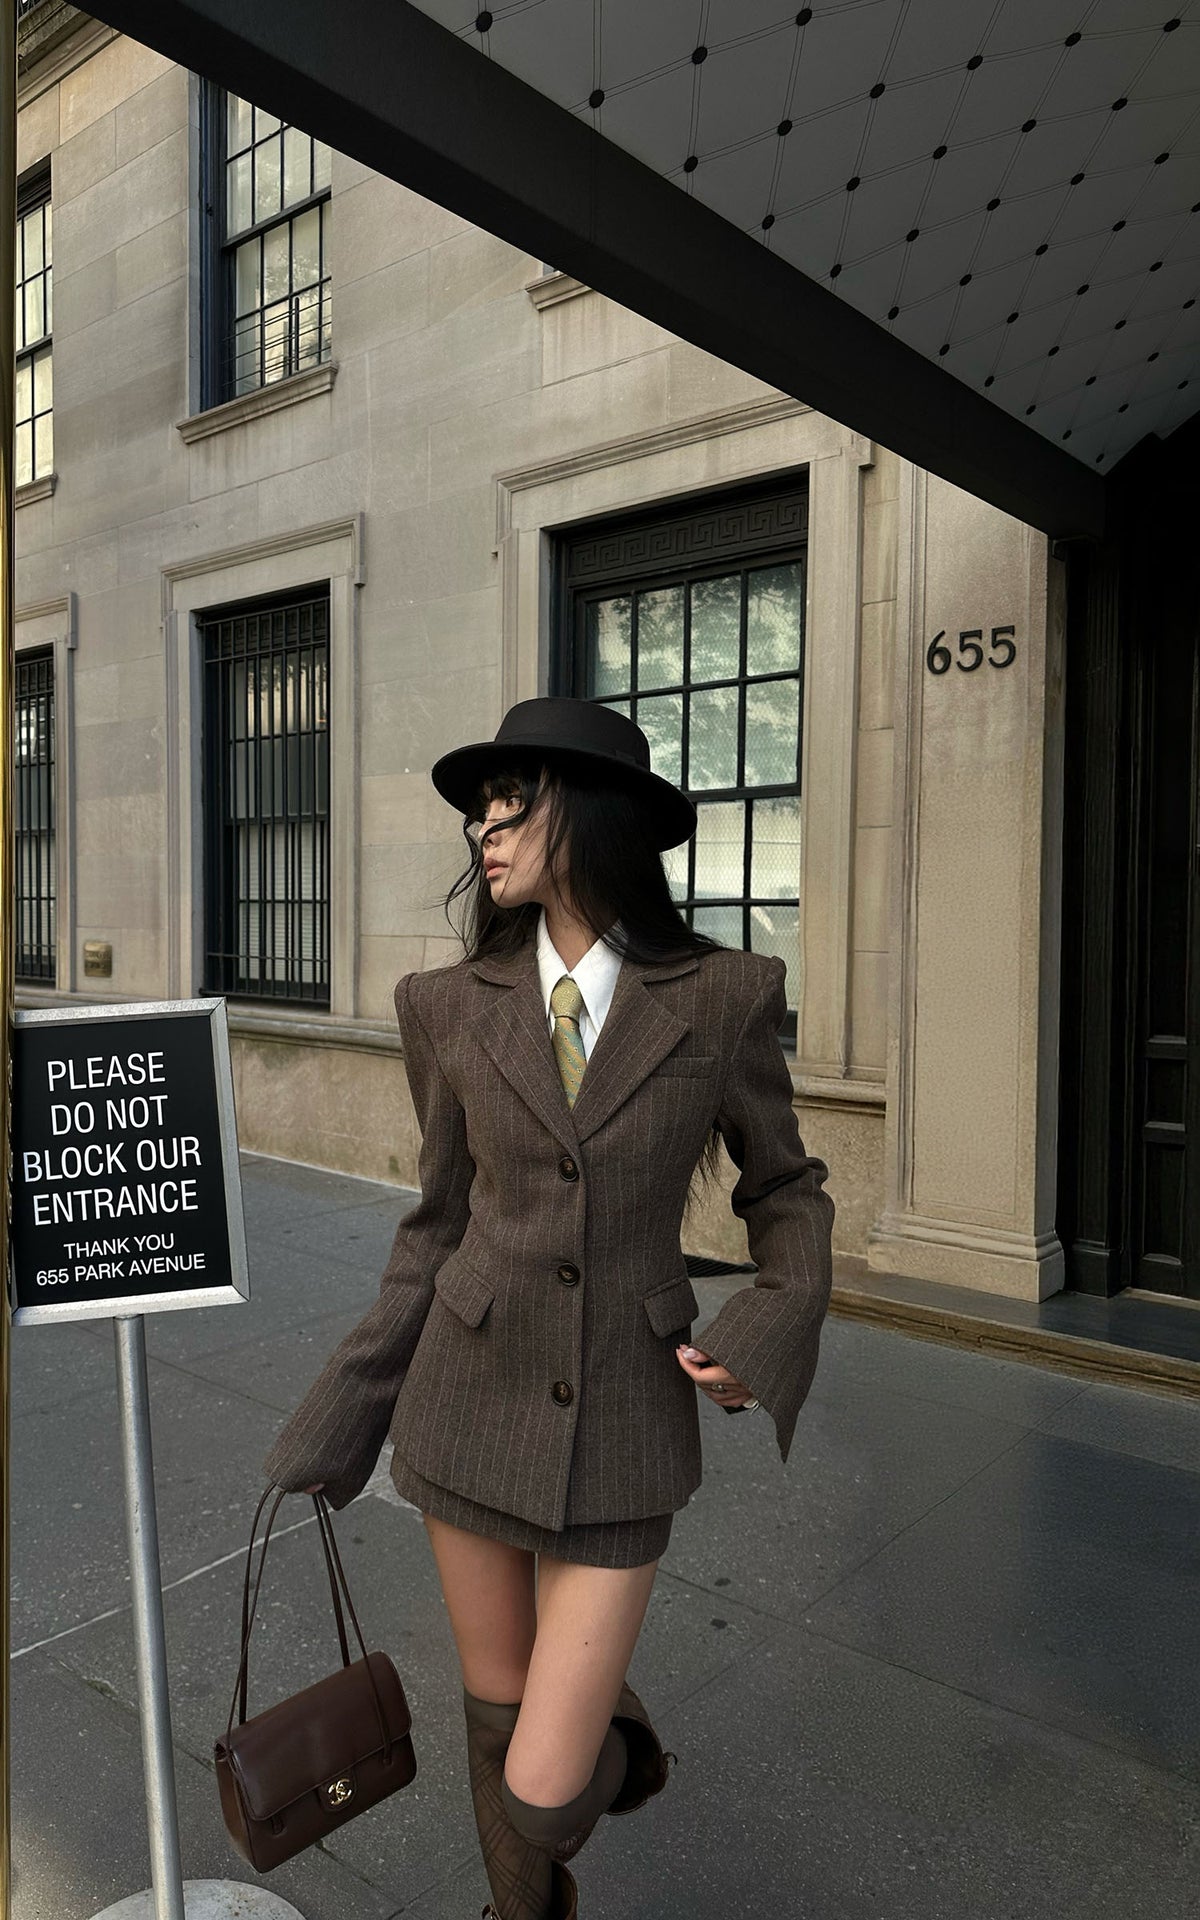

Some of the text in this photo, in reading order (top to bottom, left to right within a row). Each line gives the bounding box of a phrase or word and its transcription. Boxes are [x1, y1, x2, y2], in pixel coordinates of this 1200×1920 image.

[927, 625, 1016, 675] 655
[47, 1052, 166, 1092] PLEASE
[50, 1094, 169, 1136] DO NOT
[23, 1136, 202, 1183] BLOCK OUR
[32, 1179, 199, 1226] ENTRANCE
[63, 1232, 175, 1260] THANK YOU
[36, 1253, 206, 1286] 655 PARK AVENUE
